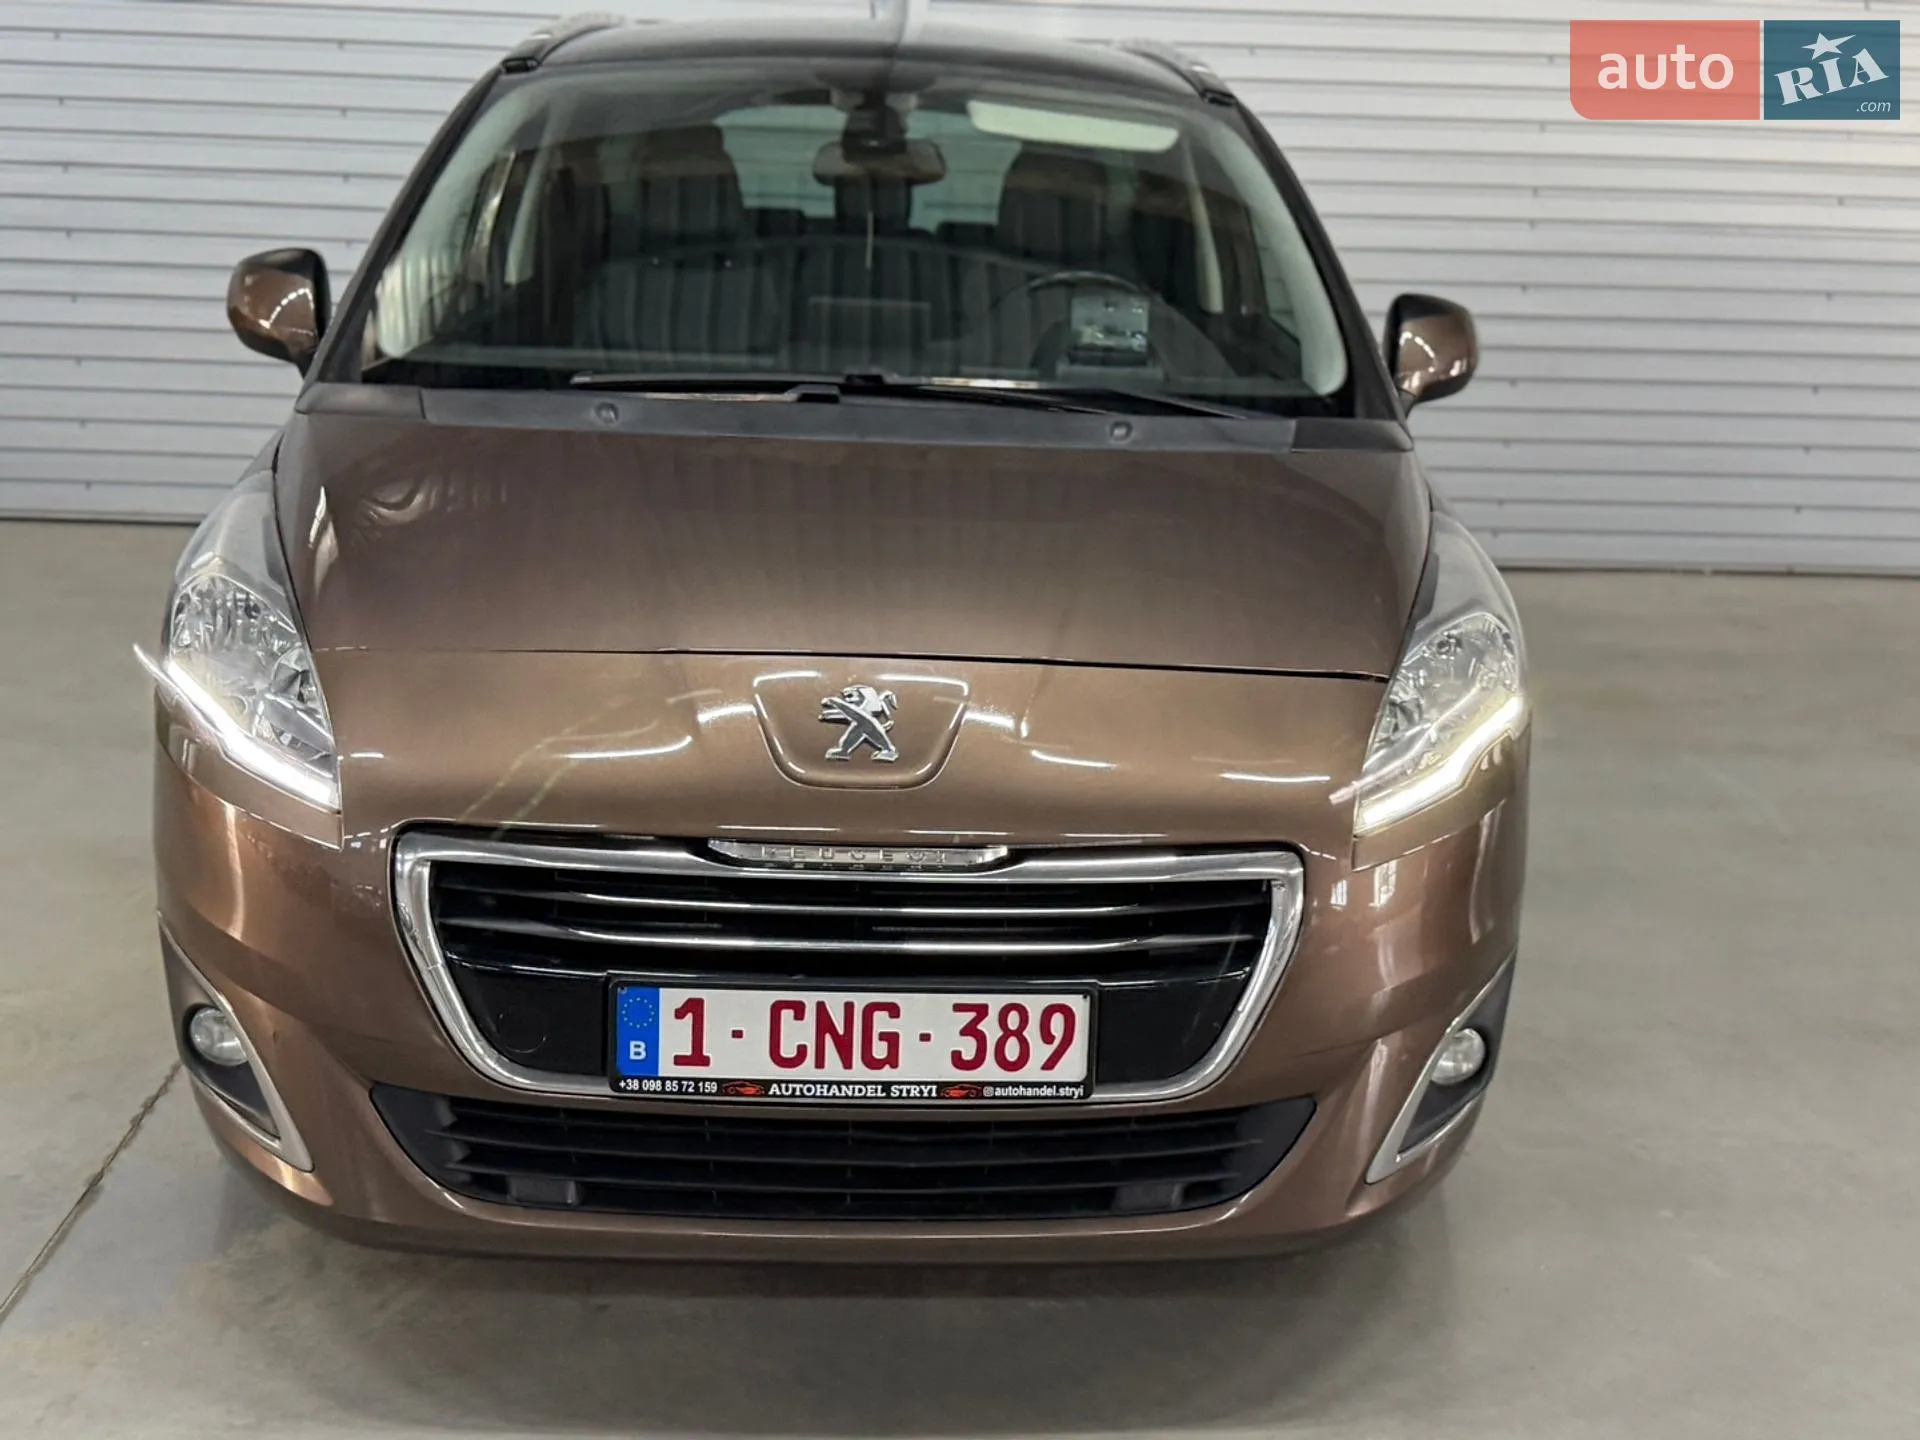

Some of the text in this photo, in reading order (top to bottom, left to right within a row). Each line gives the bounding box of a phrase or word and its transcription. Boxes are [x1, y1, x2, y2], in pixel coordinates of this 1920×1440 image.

[629, 1040, 646, 1060] B
[618, 1079, 718, 1093] +38 098 85 72 159
[768, 1083, 937, 1097] AUTOHANDEL STRYI
